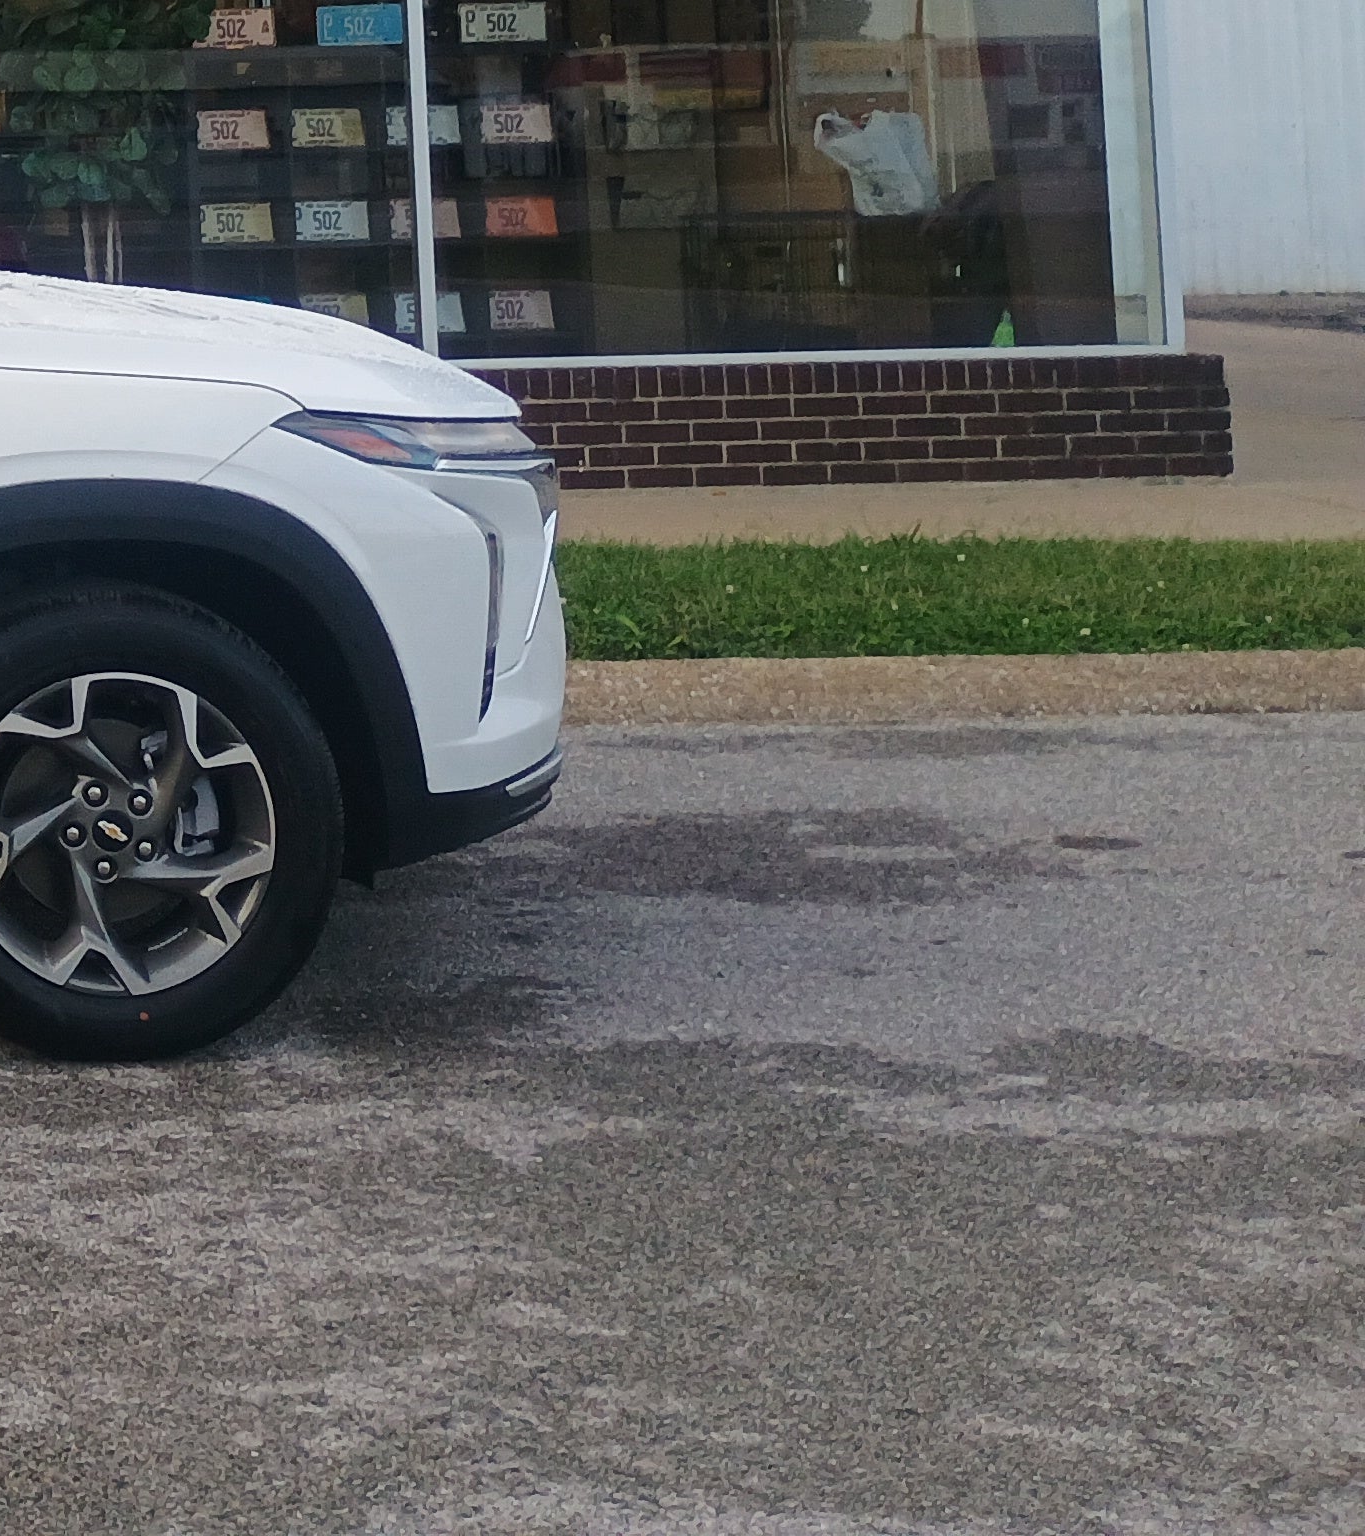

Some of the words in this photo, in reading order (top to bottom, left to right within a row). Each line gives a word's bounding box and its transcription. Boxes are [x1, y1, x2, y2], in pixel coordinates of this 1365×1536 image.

[216, 19, 247, 39] 502
[344, 17, 375, 36] 502
[486, 13, 517, 33] 502
[210, 120, 240, 140] 502
[305, 118, 336, 138] 502
[493, 113, 525, 133] 502
[216, 212, 245, 233] 502
[312, 210, 343, 230] 502
[494, 300, 525, 320] 502
